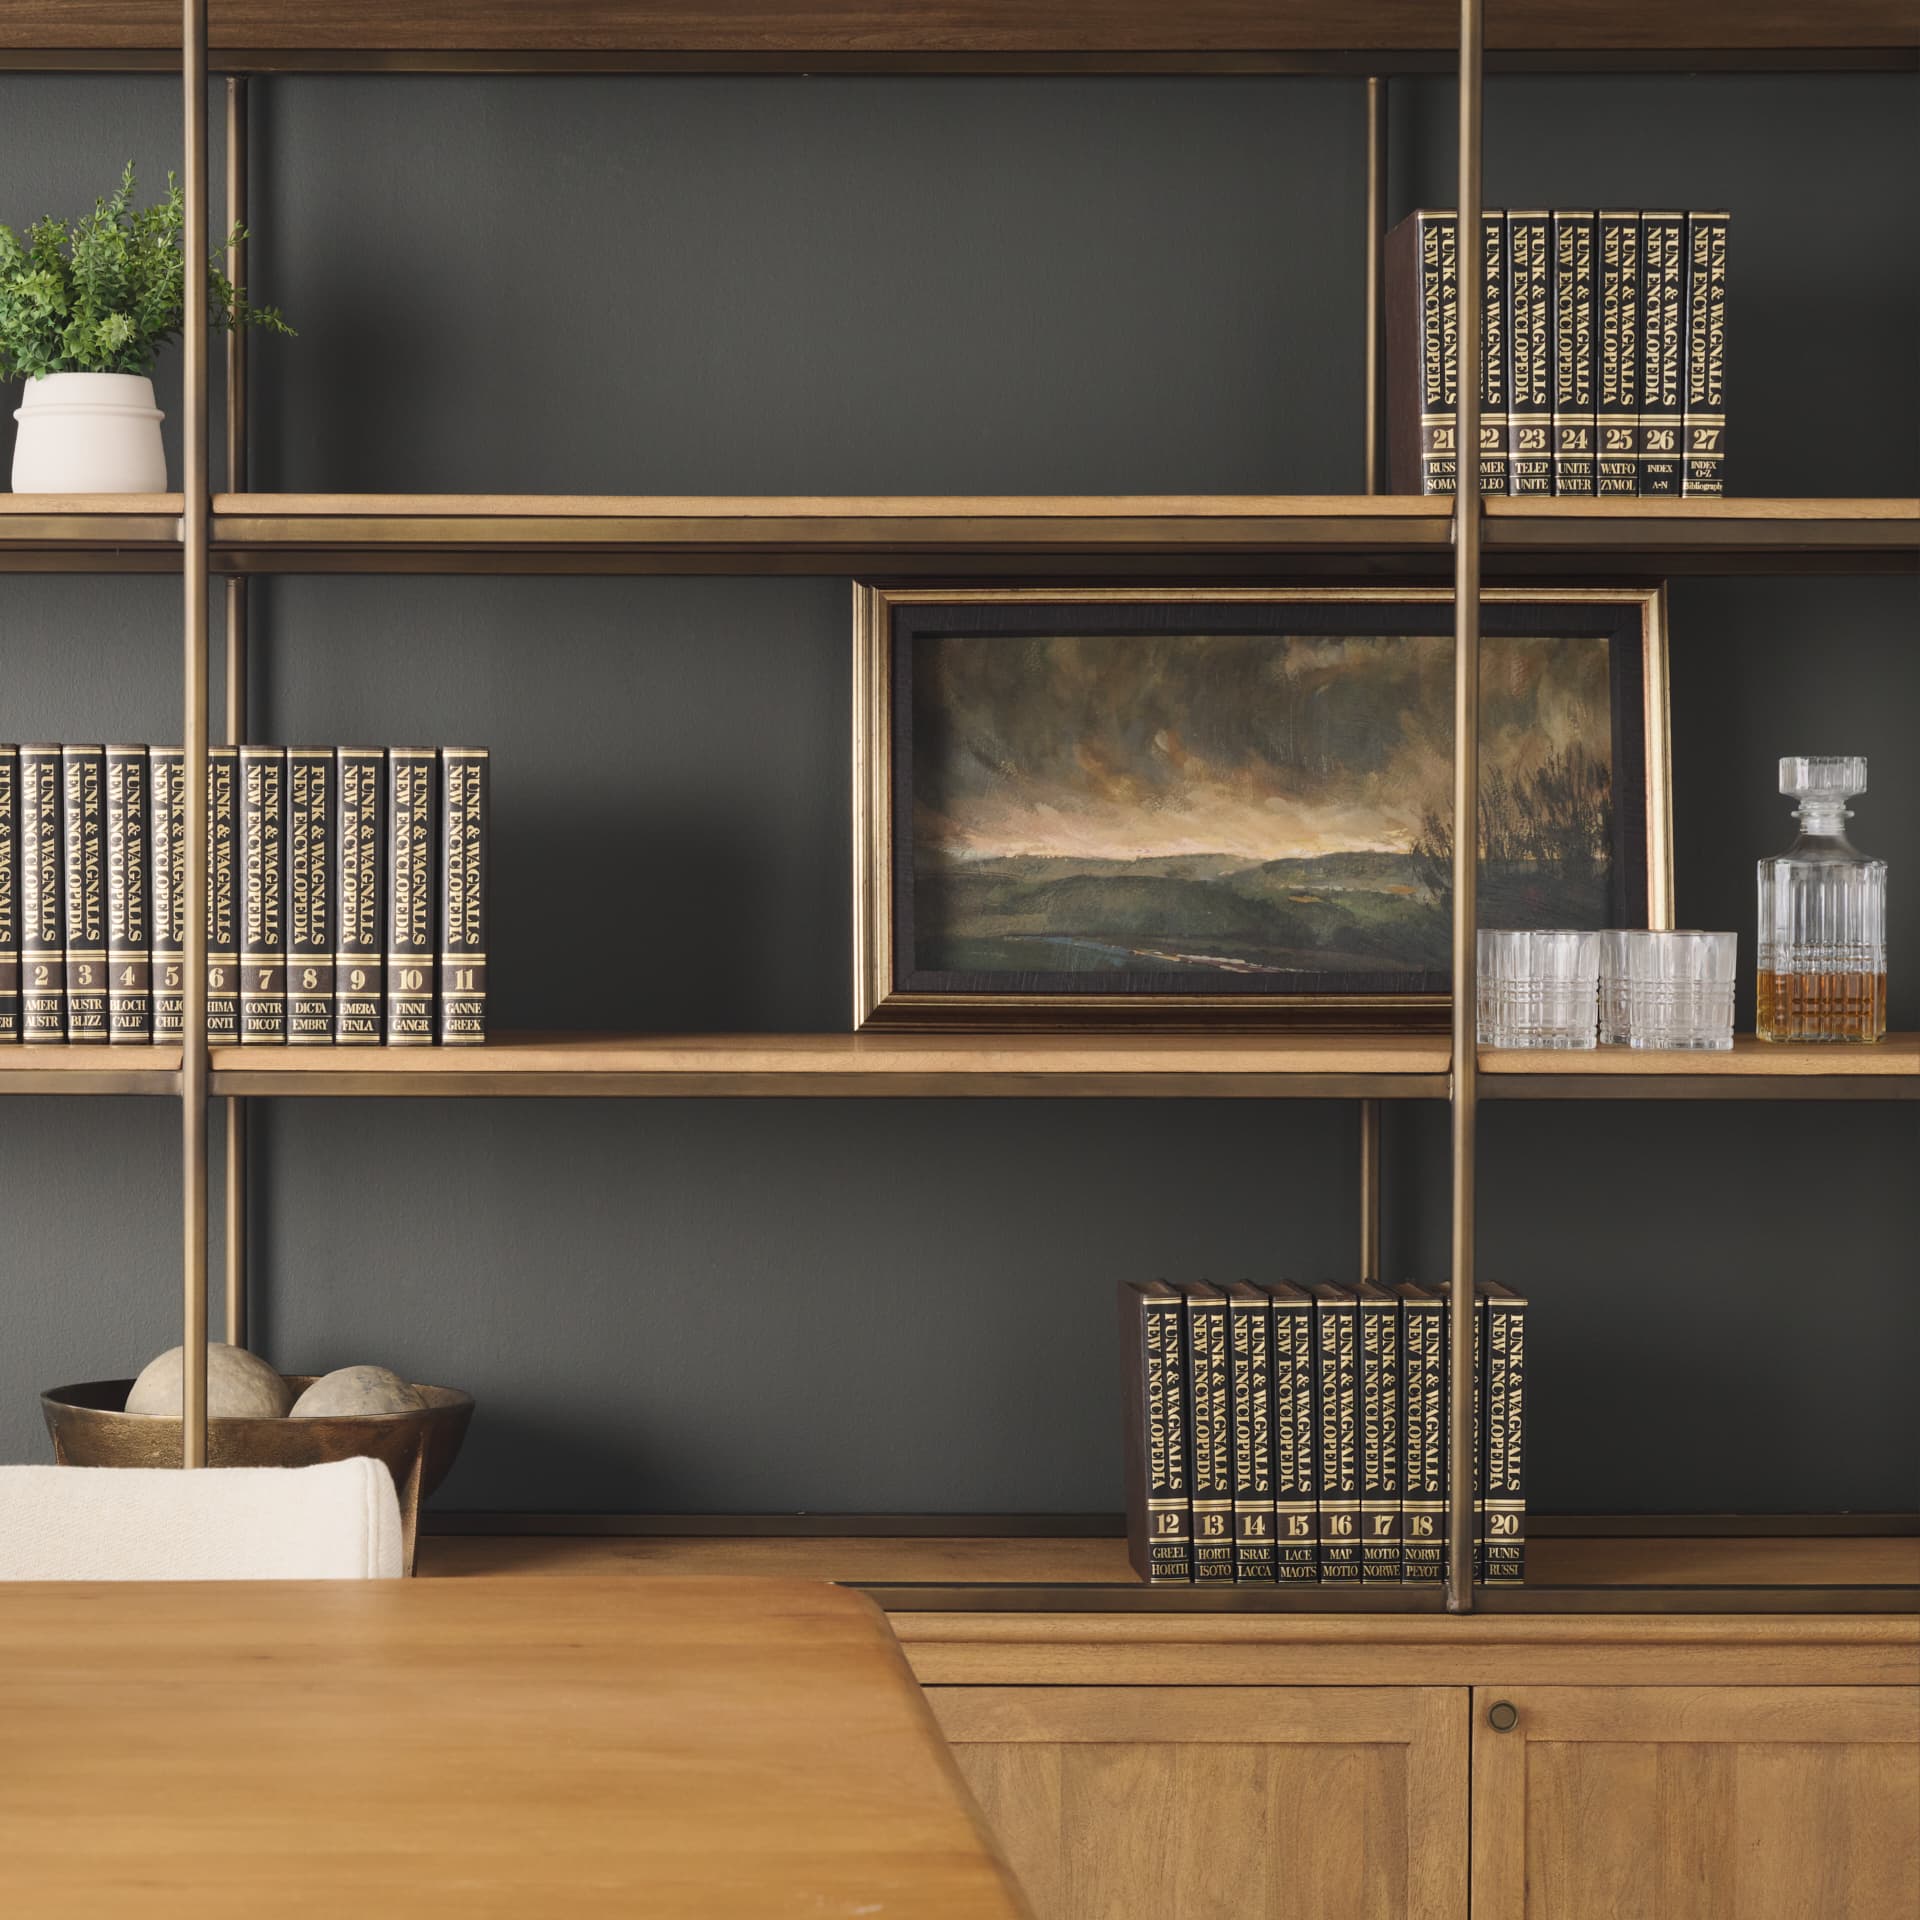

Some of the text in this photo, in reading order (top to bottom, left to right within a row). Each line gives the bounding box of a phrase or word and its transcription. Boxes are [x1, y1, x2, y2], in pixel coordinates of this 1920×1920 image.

[1514, 227, 1528, 404] NEW ENCYCLOPEDIA
[1532, 227, 1546, 404] FUNK & WAGNALLS
[1559, 227, 1572, 404] NEW ENCYCLOPEDIA
[1576, 227, 1590, 404] FUNK & WAGNALLS
[1604, 227, 1618, 404] NEW ENCYCLOPEDIA
[1621, 227, 1635, 404] FUNK & WAGNALLS
[1645, 227, 1661, 405] NEW ENCYCLOPEDIA
[1663, 227, 1678, 406] FUNK & WAGNALLS
[1690, 227, 1708, 404] NEW ENCYCLOPEDIA
[1708, 227, 1725, 406] FUNK & WAGNALLS
[1433, 428, 1455, 448] 21
[1519, 429, 1545, 448] 23
[1562, 429, 1588, 448] 24
[1606, 429, 1632, 449] 25
[1647, 429, 1674, 449] 26
[1693, 429, 1720, 449] 27
[1515, 462, 1548, 473] TELEP
[1559, 463, 1590, 473] UNITE
[1601, 463, 1635, 474] WATFO
[1691, 461, 1716, 469] INDEX
[1515, 479, 1548, 489] UNITE
[1559, 480, 1591, 490] WATER
[1600, 480, 1635, 490] ZYMOL
[67, 763, 82, 941] NEW ENCYCLOPEDIA
[85, 763, 99, 942] FUNK & WAGNALLS
[248, 765, 261, 944] NEW ENCYCLOPEDIA
[265, 766, 278, 944] FUNK & WAGNALLS
[294, 765, 307, 944] NEW ENCYCLOPEDIA
[312, 766, 325, 945] FUNK & WAGNALLS
[396, 765, 410, 944] NEW ENCYCLOPEDIA
[413, 766, 427, 944] FUNK & WAGNALLS
[450, 765, 462, 944] NEW ENCYCLOPEDIA
[466, 766, 480, 944] FUNK & WAGNALLS
[35, 966, 48, 985] 2
[79, 965, 92, 985] 3
[120, 966, 135, 985] 4
[165, 966, 179, 986] 5
[209, 967, 224, 988] 6
[258, 970, 273, 989] 7
[303, 969, 317, 989] 8
[350, 970, 365, 990] 9
[400, 969, 423, 990] 10
[455, 969, 474, 989] 11
[25, 1000, 57, 1010] AMERI
[71, 999, 102, 1009] AUSTR
[110, 1000, 145, 1011] BLOCH
[246, 1003, 282, 1013] CONTR
[295, 1003, 326, 1013] DICTA
[340, 1003, 376, 1014] EMERA
[396, 1003, 425, 1014] FINNI
[446, 1003, 481, 1014] GANNE
[25, 1016, 59, 1026] AUSTR
[71, 1015, 102, 1026] BLIZZ
[112, 1016, 142, 1027] CALIF
[248, 1019, 281, 1030] DICOT
[293, 1019, 328, 1030] EMBRY
[343, 1020, 374, 1031] FINLA
[393, 1020, 429, 1030] GANGR
[447, 1020, 480, 1030] GREEK
[1147, 1313, 1165, 1490] NEW ENCYCLOPEDIA
[1165, 1313, 1182, 1490] FUNK & WAGNALLS
[1234, 1315, 1250, 1491] NEW ENCYCLOPEDIA
[1252, 1315, 1268, 1491] FUNK & WAGNALLS
[1323, 1314, 1337, 1491] NEW ENCYCLOPEDIA
[1340, 1315, 1354, 1491] FUNK & WAGNALLS
[1365, 1314, 1379, 1491] NEW ENCYCLOPEDIA
[1382, 1315, 1395, 1491] FUNK & WAGNALLS
[1490, 1313, 1506, 1490] NEW ENCYCLOPEDIA
[1507, 1314, 1523, 1491] FUNK & WAGNALLS
[1156, 1514, 1179, 1534] 12
[1202, 1515, 1224, 1535] 13
[1243, 1515, 1265, 1535] 14
[1287, 1516, 1309, 1535] 15
[1329, 1515, 1352, 1535] 16
[1374, 1515, 1394, 1535] 17
[1411, 1516, 1433, 1535] 18
[1491, 1514, 1518, 1535] 20
[1153, 1547, 1187, 1558] GREEL
[1199, 1548, 1230, 1560] HORTI
[1240, 1549, 1270, 1559] ISRAE
[1285, 1550, 1312, 1560] LACE
[1330, 1549, 1352, 1559] MAP
[1364, 1548, 1399, 1559] MOTIO
[1489, 1548, 1519, 1558] PUNIS
[1200, 1565, 1231, 1576] ISOTO
[1238, 1566, 1271, 1576] LACCA
[1280, 1567, 1316, 1577] MAOTS
[1363, 1565, 1400, 1576] NORWE
[1406, 1566, 1439, 1576] PEYOT
[1490, 1564, 1519, 1575] RUSSI
